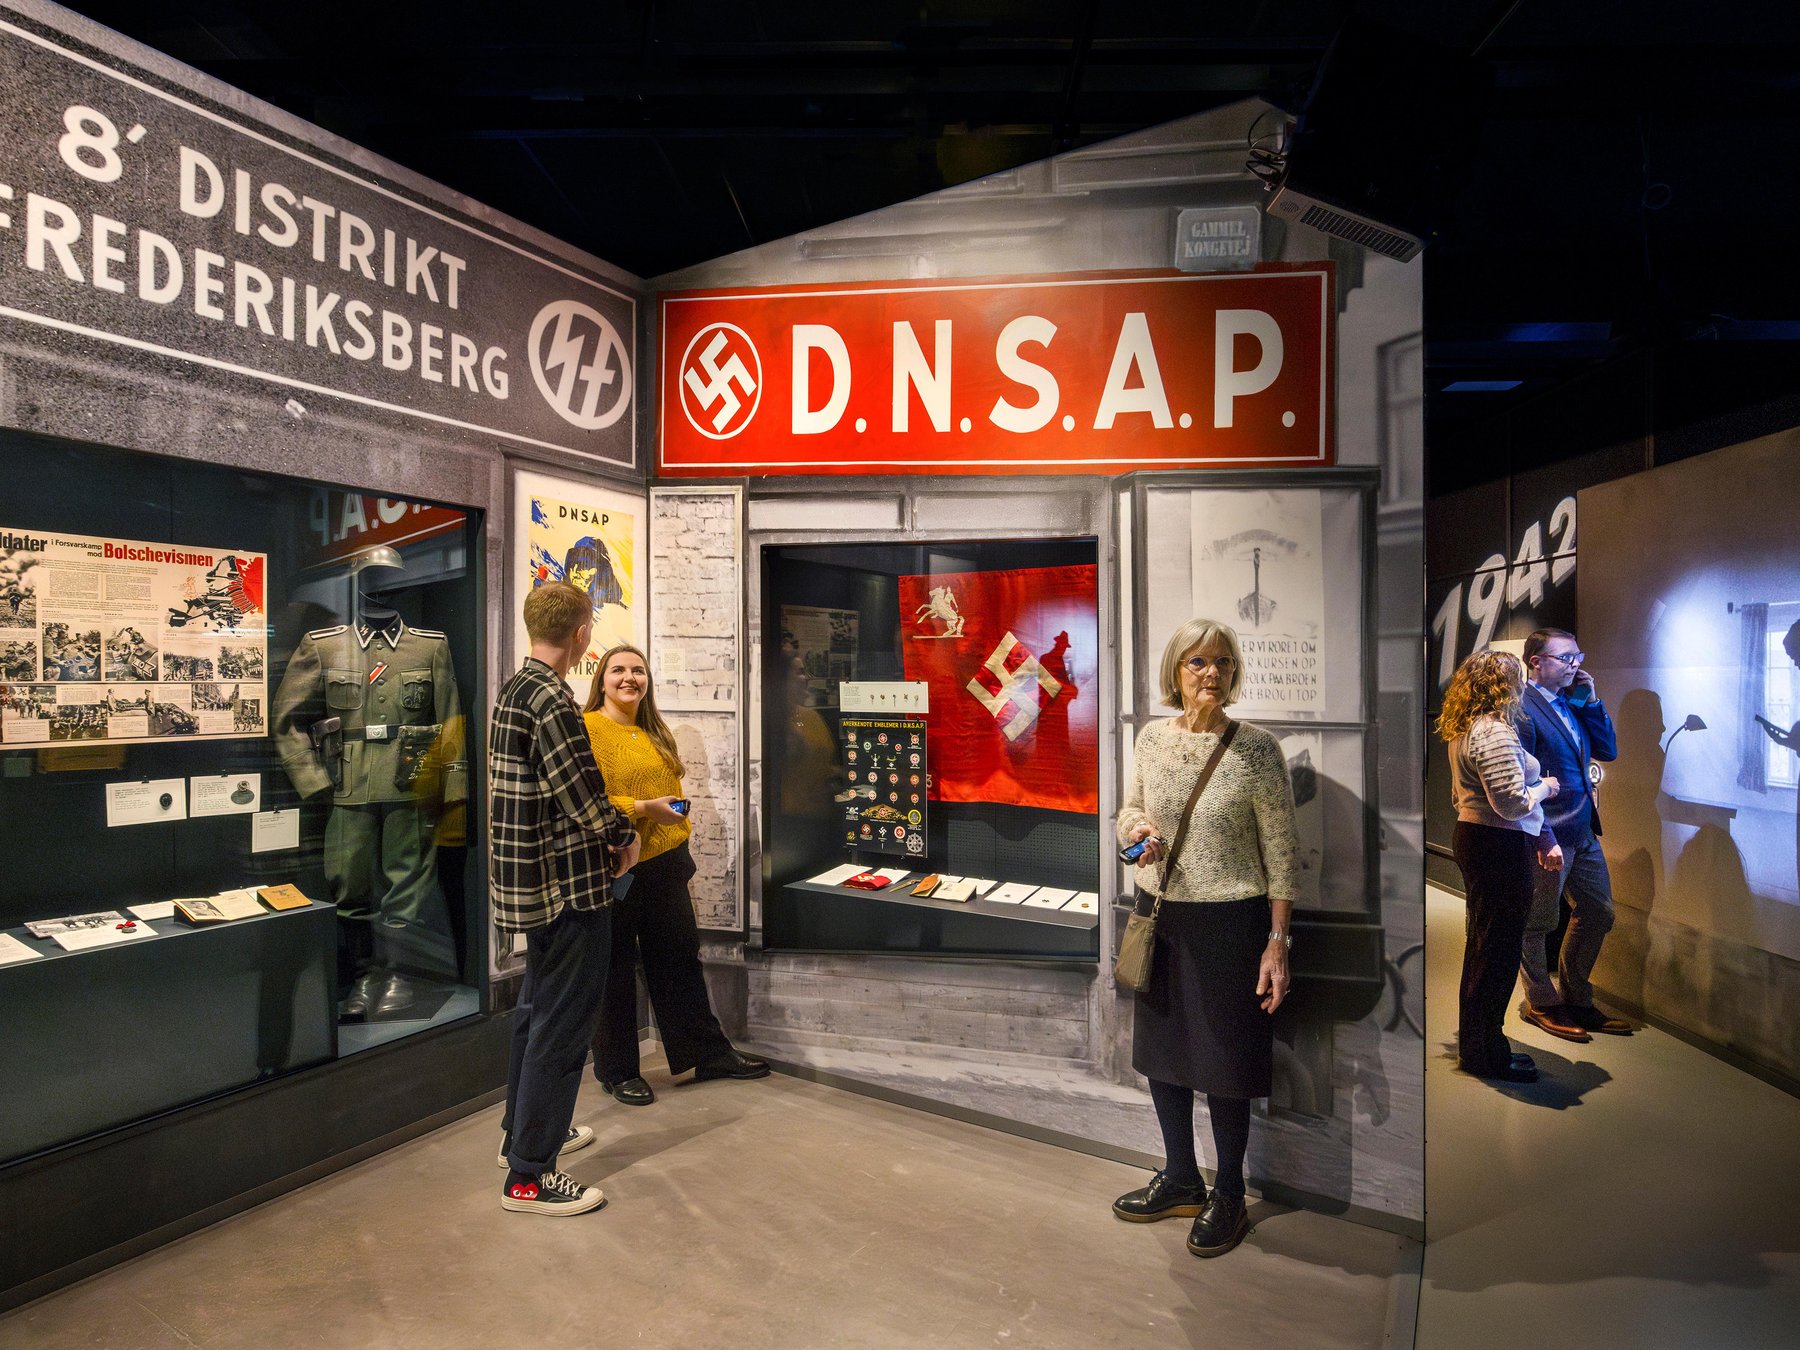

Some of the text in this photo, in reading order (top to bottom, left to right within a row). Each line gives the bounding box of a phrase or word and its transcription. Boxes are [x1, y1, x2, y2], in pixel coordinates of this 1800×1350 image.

[180, 145, 467, 310] DISTRIKT
[791, 309, 1296, 435] D.N.S.A.P.
[559, 505, 610, 526] DNSAP
[51, 538, 54, 546] i
[55, 539, 103, 550] Forsvarskamp
[104, 542, 213, 567] Bolschevismen
[1432, 496, 1577, 692] 1942
[1256, 640, 1265, 653] VI
[1301, 640, 1316, 654] OM
[1257, 656, 1298, 669] KURSEN
[1301, 657, 1316, 669] OP
[1286, 673, 1317, 685] BROEN
[1296, 689, 1317, 701] TOP
